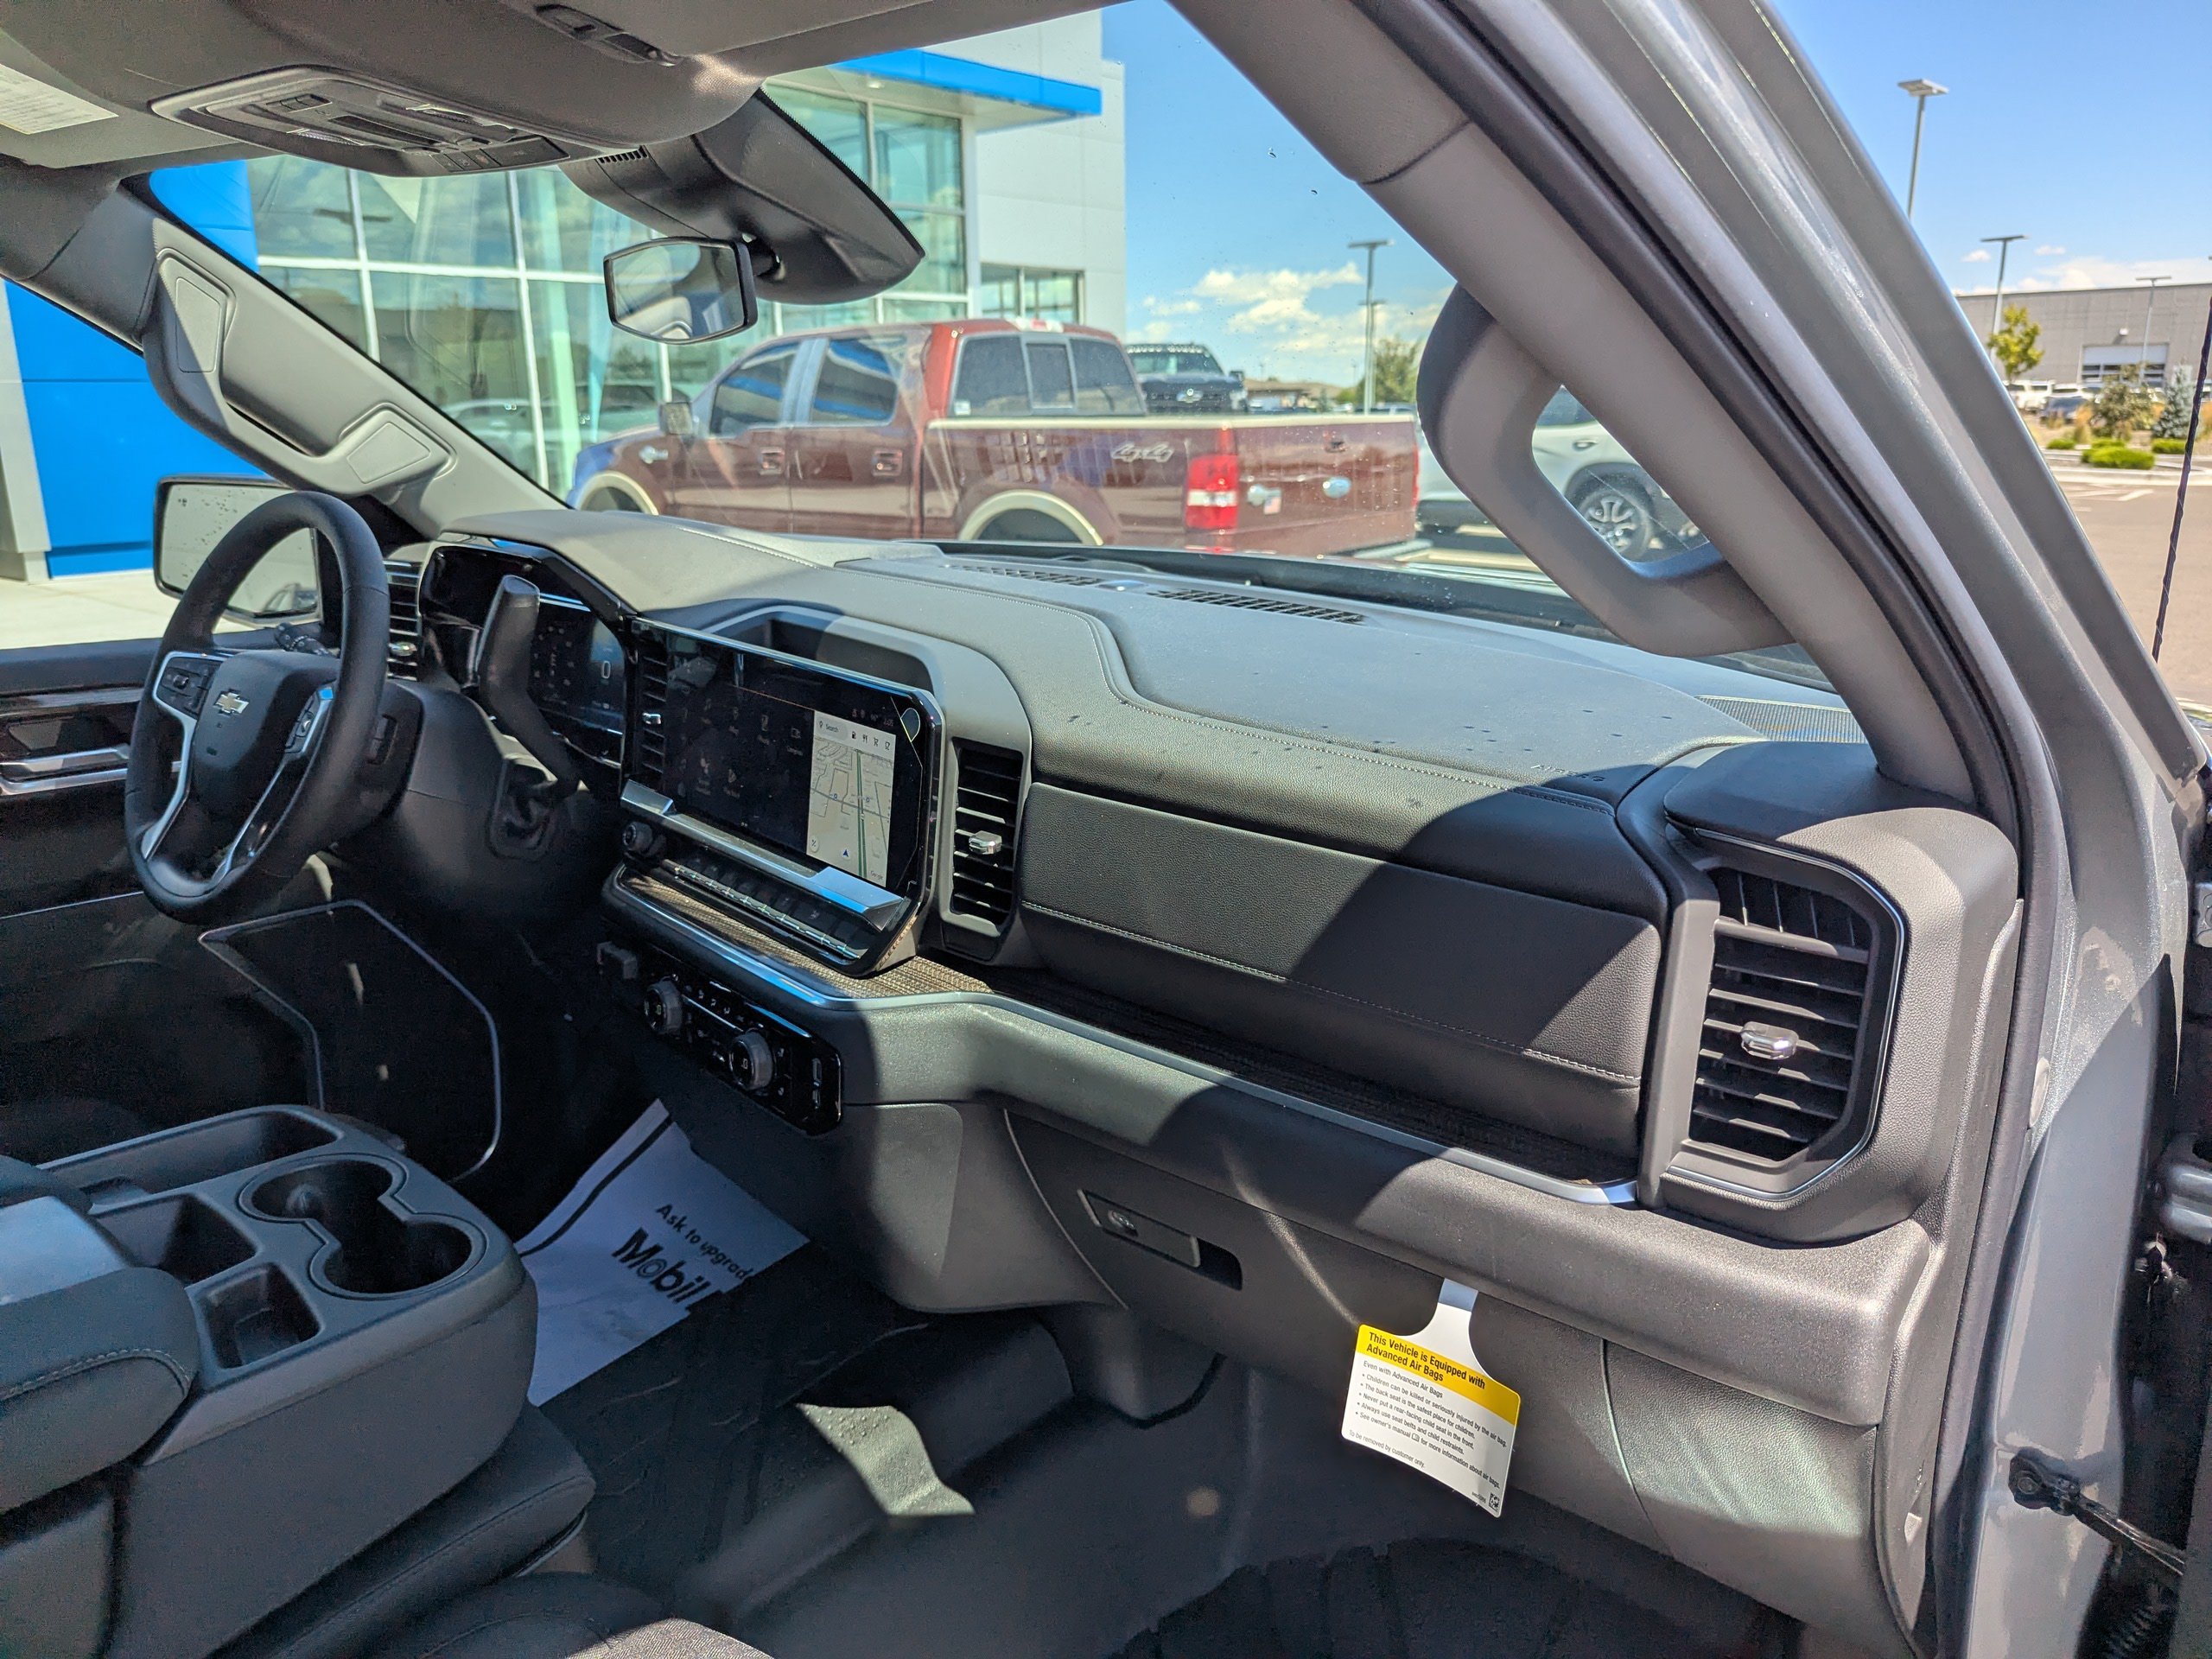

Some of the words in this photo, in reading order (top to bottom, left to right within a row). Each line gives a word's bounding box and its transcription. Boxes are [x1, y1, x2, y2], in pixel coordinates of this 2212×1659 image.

[1110, 442, 1174, 462] 4x4
[826, 724, 839, 733] Search
[611, 1227, 711, 1303] Mobil
[656, 1204, 687, 1233] Ask
[685, 1228, 702, 1243] to
[700, 1242, 753, 1280] upgrad
[1363, 1360, 1377, 1370] Even
[1379, 1365, 1391, 1376] with
[1392, 1371, 1420, 1388] Advanced
[1429, 1387, 1443, 1398] Bags
[1366, 1344, 1408, 1366] Advanced
[1409, 1359, 1421, 1371] Air
[1424, 1365, 1444, 1382] Bags
[1369, 1332, 1386, 1346] This
[1389, 1338, 1419, 1358] Vehicle
[1421, 1351, 1427, 1362] is
[1430, 1356, 1466, 1380] Equipped
[1469, 1374, 1485, 1389] with
[1361, 1402, 1380, 1414] Always
[1391, 1415, 1403, 1424] seat
[1403, 1420, 1416, 1430] belts
[1427, 1430, 1440, 1441] child
[1440, 1438, 1464, 1455] restraints.
[1363, 1393, 1379, 1403] Never
[1394, 1405, 1422, 1423] rear-facing
[1422, 1418, 1434, 1428] child
[1436, 1425, 1446, 1434] seat
[1462, 1439, 1474, 1450] front.
[1364, 1383, 1375, 1392] The
[1376, 1388, 1389, 1398] back
[1389, 1394, 1401, 1402] seat
[1417, 1405, 1432, 1416] safest
[1433, 1412, 1446, 1423] place
[1455, 1424, 1475, 1440] children.
[1367, 1374, 1389, 1388] Children
[1409, 1391, 1424, 1402] killed
[1432, 1402, 1455, 1418] seriously
[1456, 1414, 1474, 1427] injured
[1474, 1422, 1481, 1431] by
[1481, 1427, 1490, 1436] the
[1497, 1436, 1507, 1448] bag.
[1360, 1412, 1370, 1421] See
[1370, 1417, 1391, 1429] owner's
[1392, 1424, 1412, 1438] manual
[1428, 1443, 1441, 1452] more
[1441, 1450, 1469, 1469] information
[1469, 1464, 1483, 1476] about
[1490, 1476, 1500, 1489] bags.
[1363, 1436, 1384, 1448] removed
[1392, 1448, 1414, 1462] customer
[1414, 1459, 1426, 1468] only.
